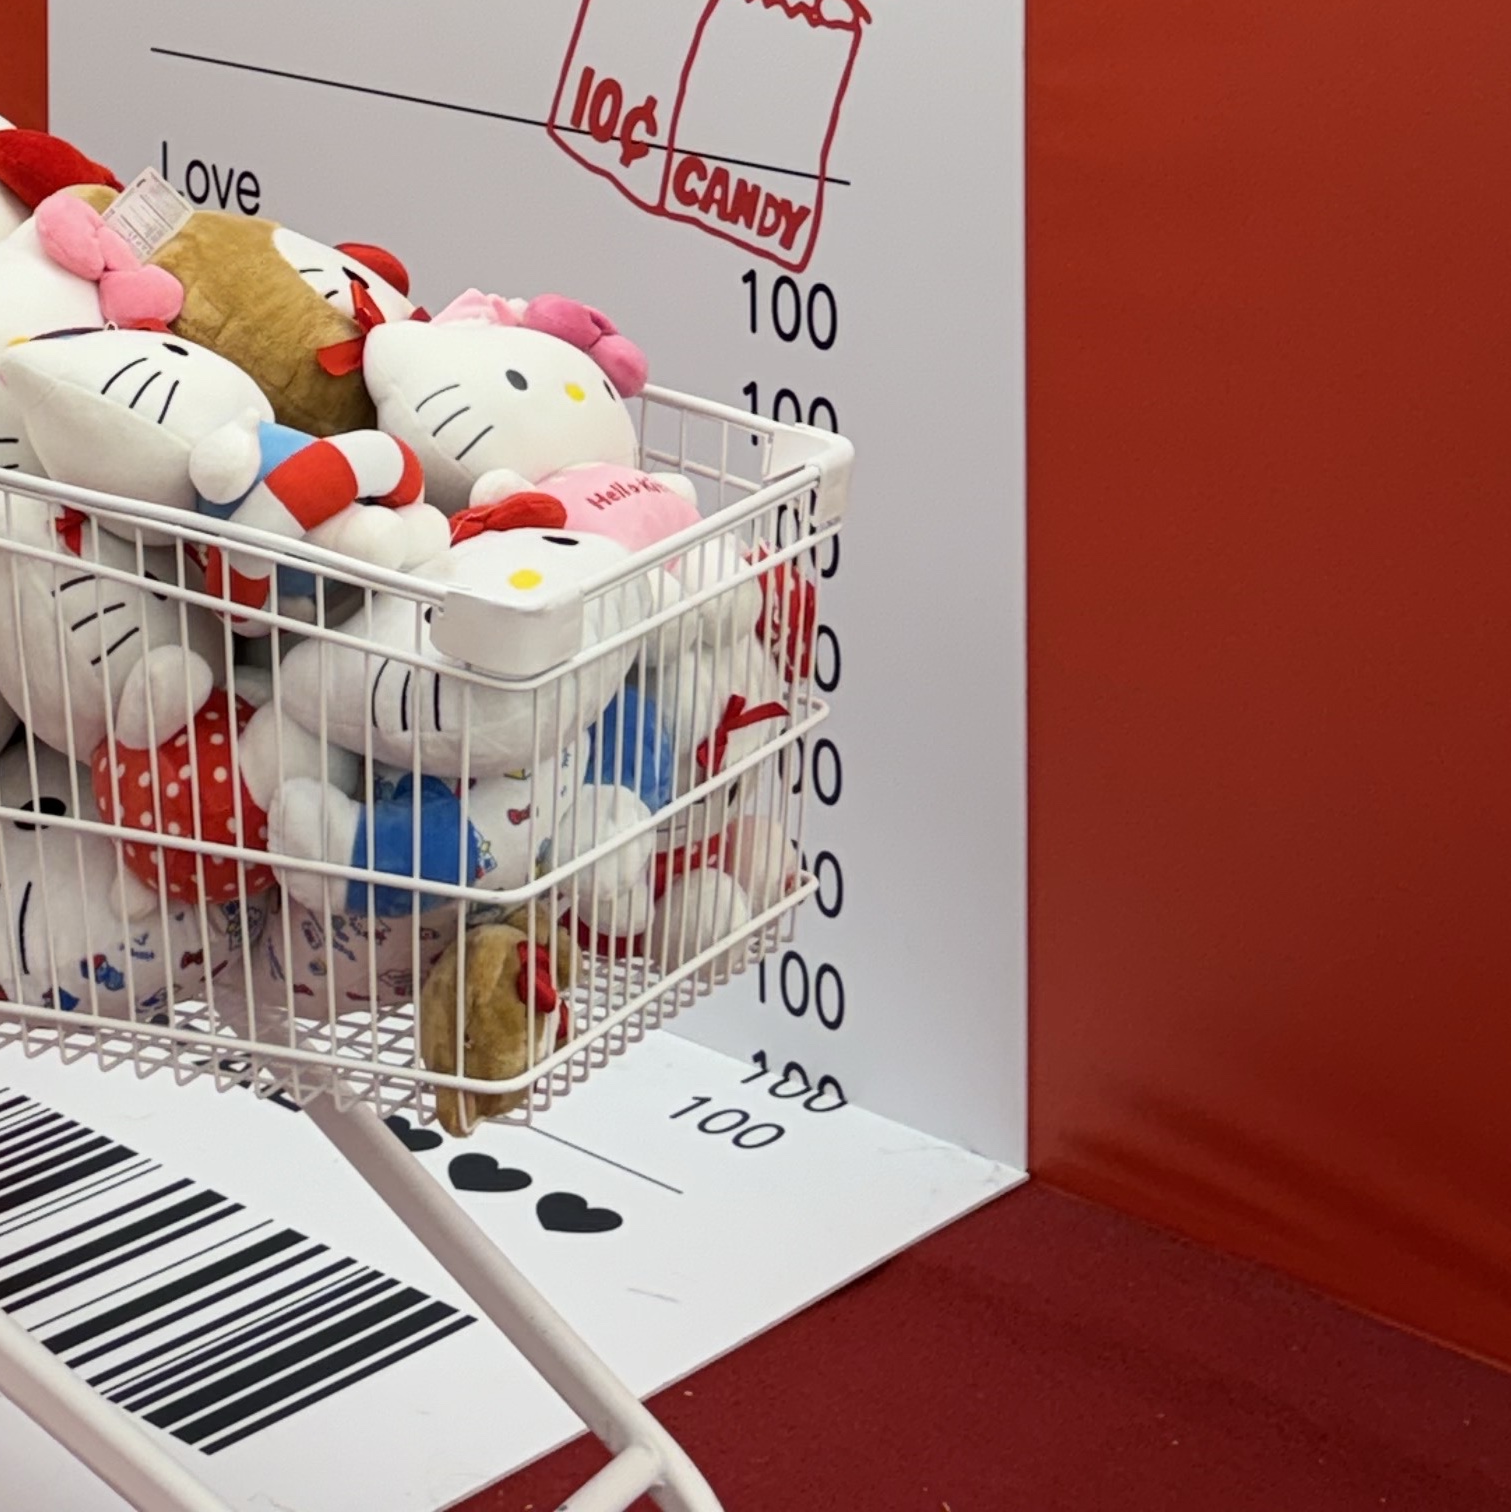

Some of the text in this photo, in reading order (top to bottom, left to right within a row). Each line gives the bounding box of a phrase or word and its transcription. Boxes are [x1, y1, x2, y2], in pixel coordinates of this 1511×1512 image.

[162, 140, 261, 216] Love
[672, 155, 811, 251] CANDY
[741, 268, 838, 351] 100
[586, 481, 640, 510] Hello
[750, 938, 845, 1031] 100
[740, 1049, 849, 1112] 100
[669, 1096, 786, 1150] 100
